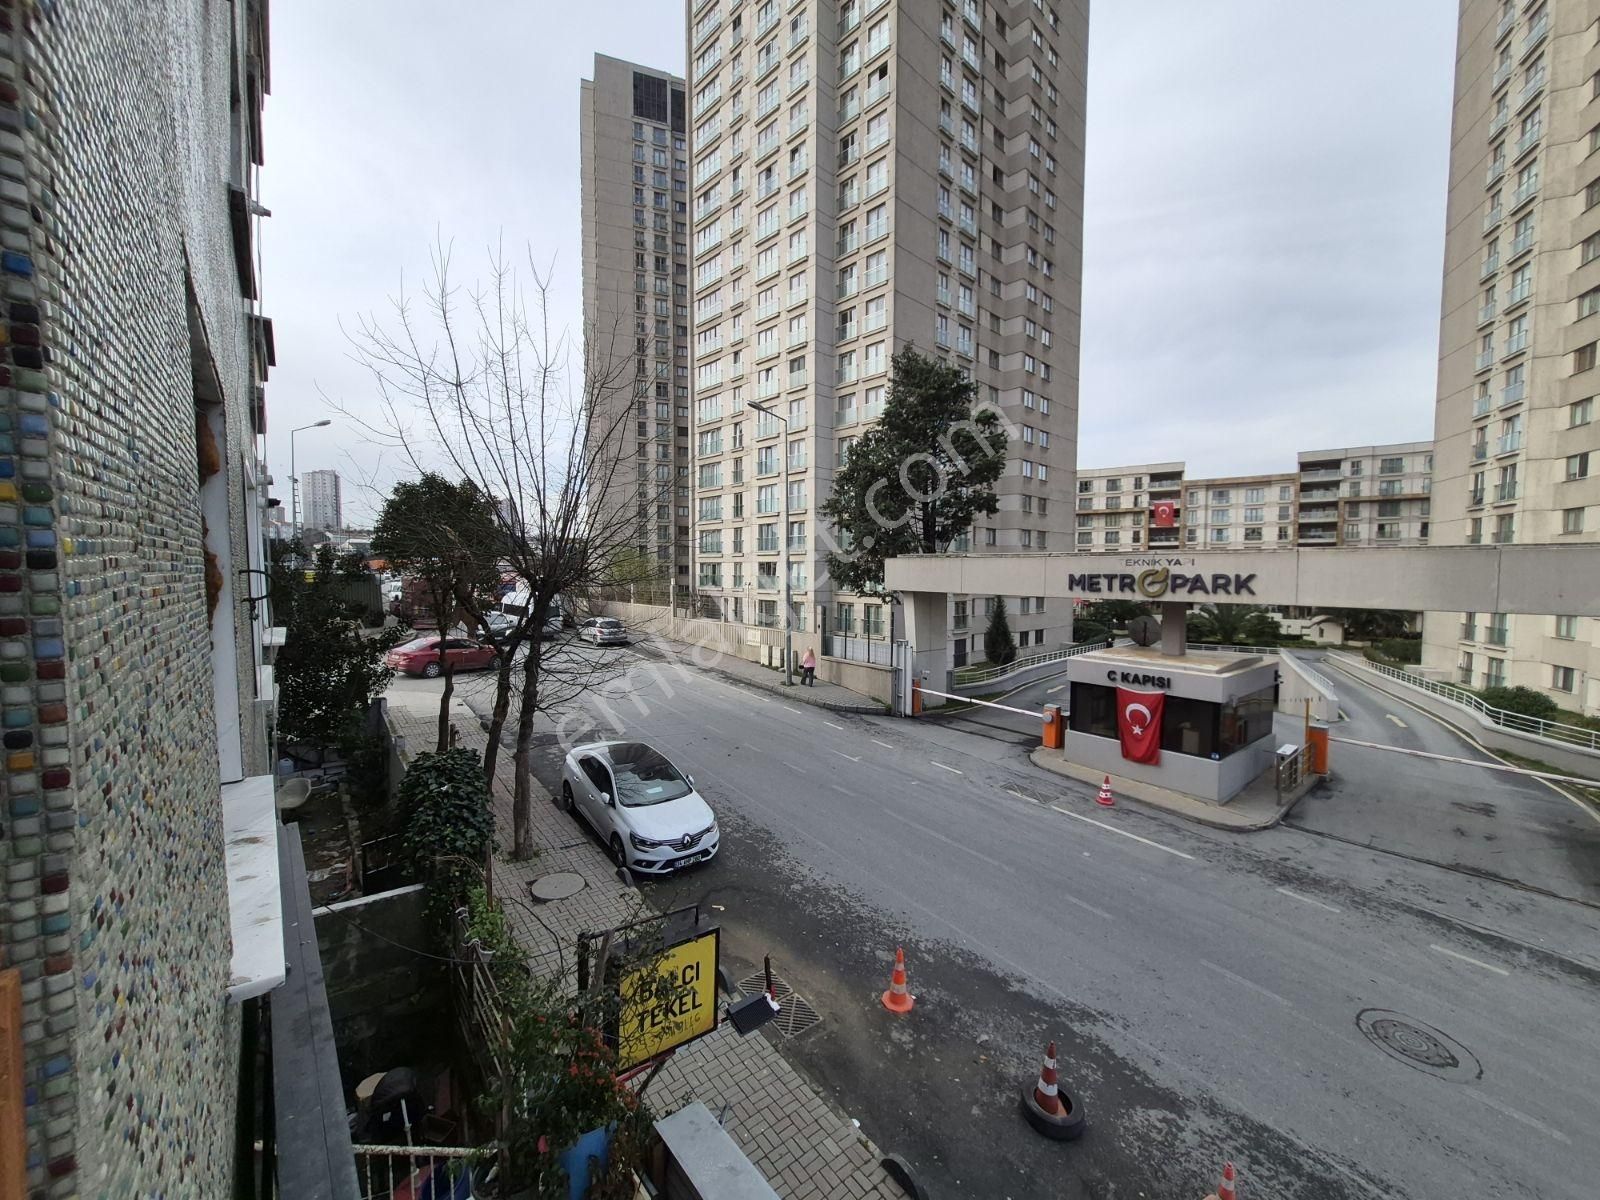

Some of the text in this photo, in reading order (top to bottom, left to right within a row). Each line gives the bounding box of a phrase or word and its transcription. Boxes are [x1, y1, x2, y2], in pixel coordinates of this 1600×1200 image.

[1119, 558, 1195, 567] EKNIK YAI
[1068, 567, 1256, 598] METROPARK
[1107, 670, 1117, 682] C
[640, 961, 701, 1003] BLCI
[637, 991, 703, 1033] TEKEL
